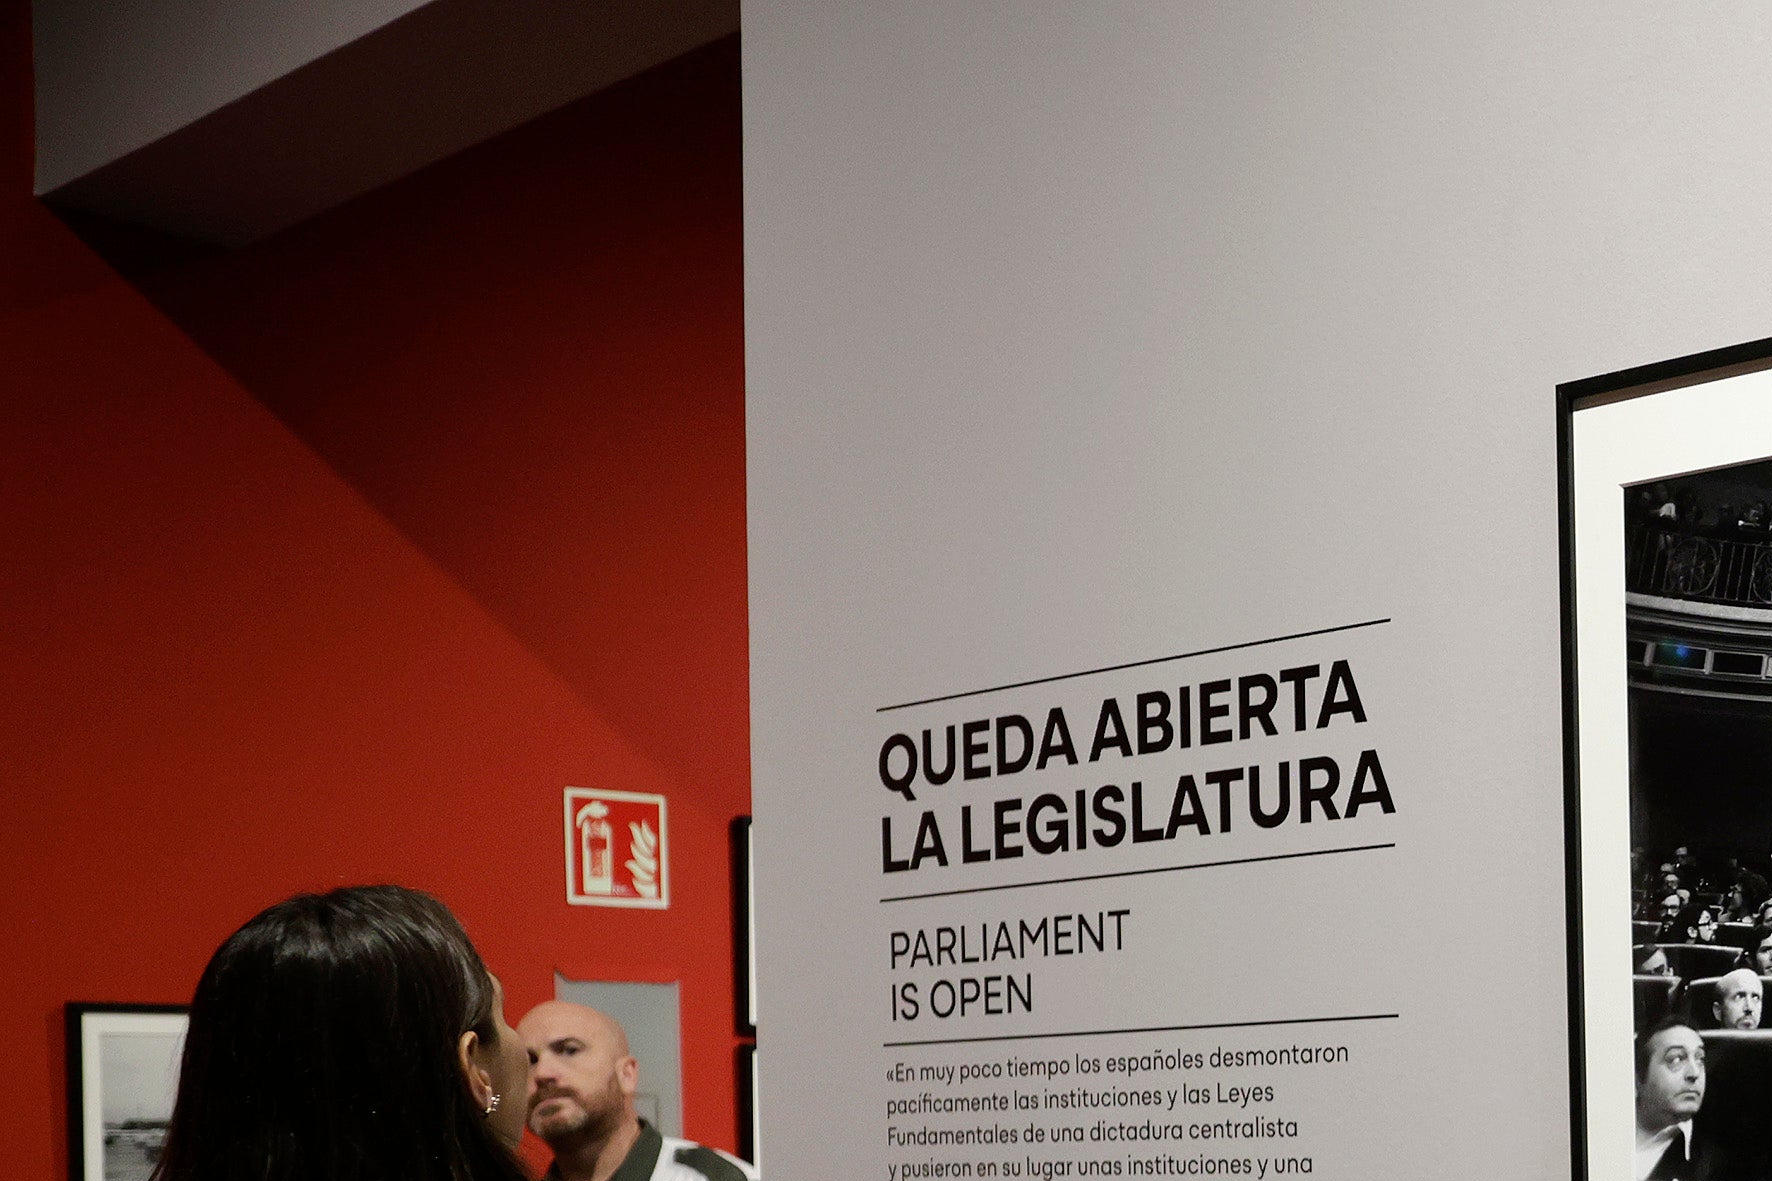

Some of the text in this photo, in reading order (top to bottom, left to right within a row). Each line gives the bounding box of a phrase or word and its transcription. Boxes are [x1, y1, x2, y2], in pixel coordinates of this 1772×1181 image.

[879, 660, 1367, 801] QUEDA ABIERTA
[882, 750, 1396, 874] LA LEGISLATURA
[891, 910, 1130, 969] PARLIAMENT
[892, 974, 1031, 1020] IS OPEN
[887, 1045, 1348, 1086] «En muy poco tiempo los españoles desmontaron
[888, 1082, 1274, 1119] pacíficamente las instituciones y las Leyes
[888, 1116, 1297, 1146] Fundamentales de una dictadura centralista
[902, 1158, 971, 1181] pusieron
[977, 1162, 996, 1177] en
[1003, 1162, 1020, 1176] su
[1027, 1156, 1072, 1181] lugar
[1078, 1161, 1122, 1176] unas
[1128, 1154, 1252, 1174] instituciones
[1258, 1159, 1268, 1180] y
[1275, 1158, 1312, 1174] una
